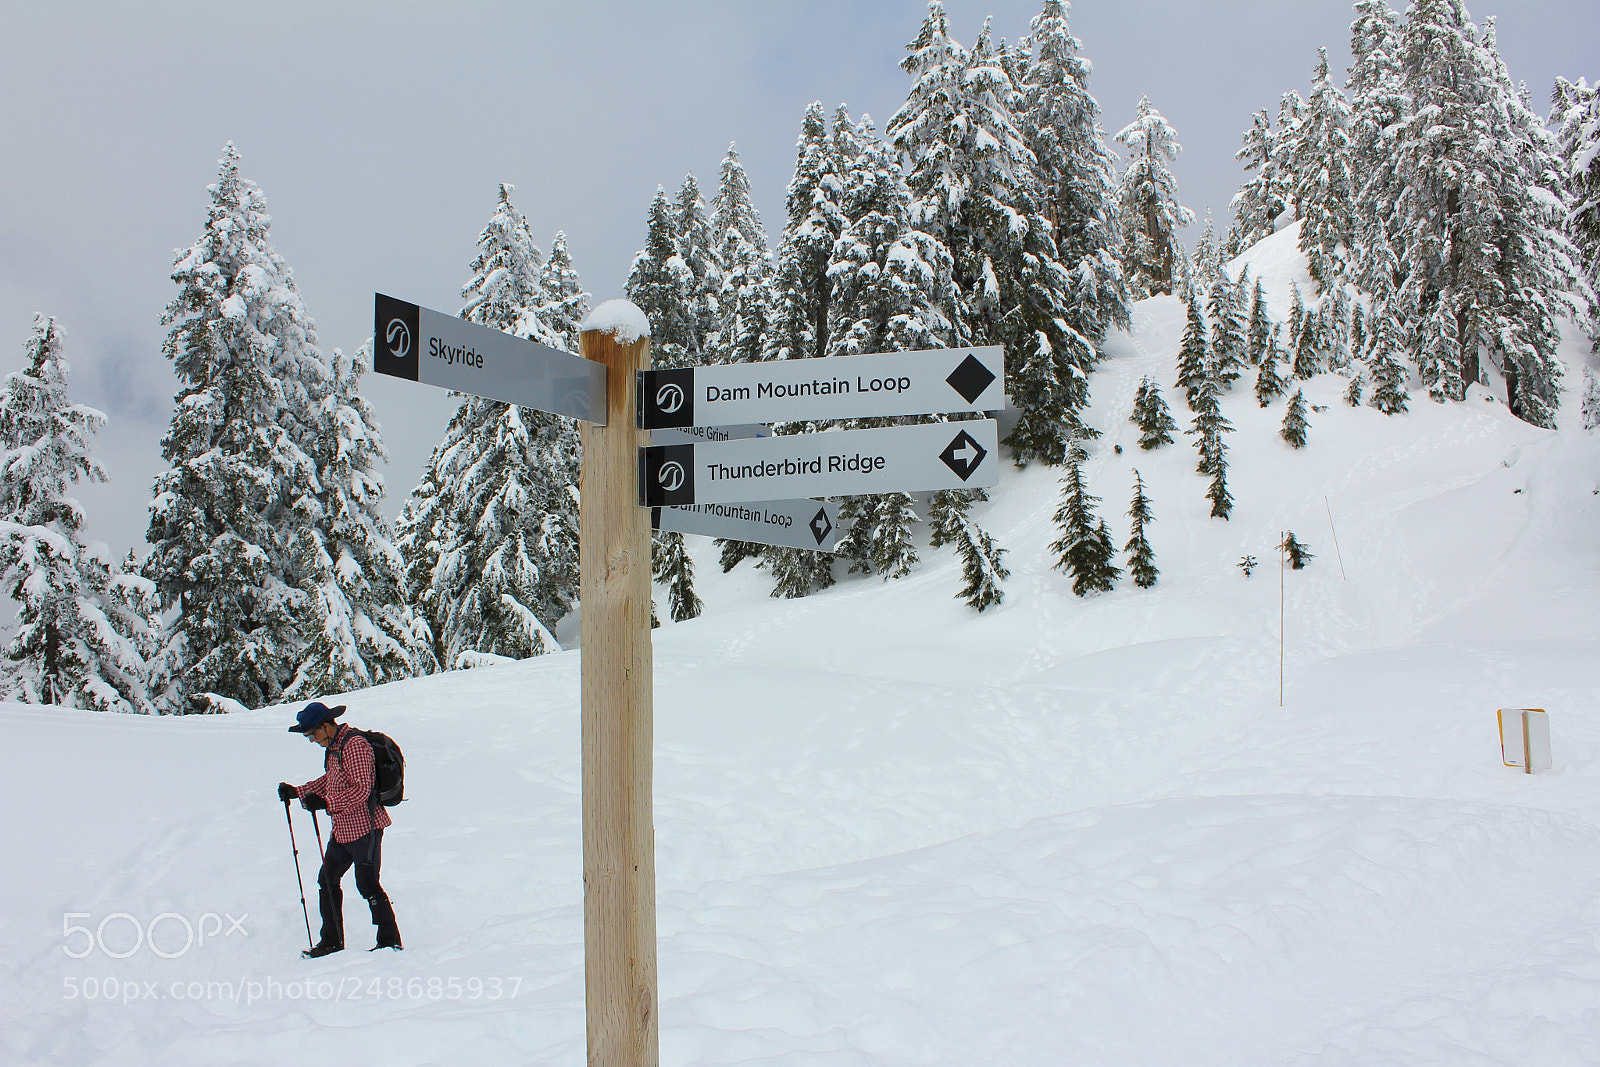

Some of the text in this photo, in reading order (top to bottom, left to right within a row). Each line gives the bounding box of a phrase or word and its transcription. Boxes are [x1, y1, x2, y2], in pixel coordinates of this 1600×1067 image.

[429, 337, 484, 369] Skyride
[706, 376, 911, 402] Dam Mountain Loop
[707, 453, 885, 480] Thunderbird Ridge
[704, 503, 761, 522] Mountain
[764, 509, 793, 529] Loop
